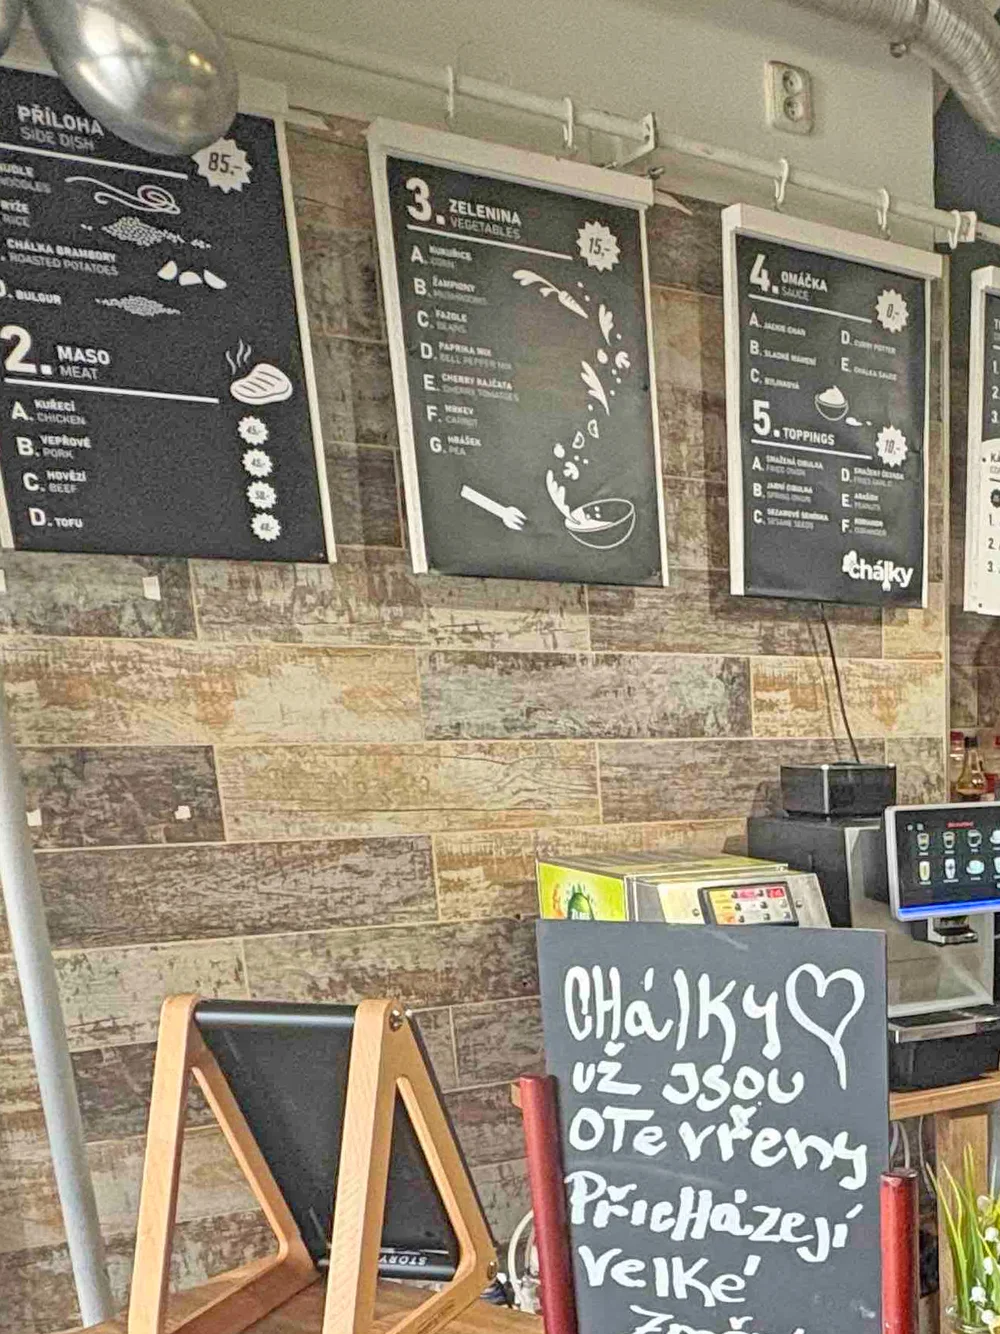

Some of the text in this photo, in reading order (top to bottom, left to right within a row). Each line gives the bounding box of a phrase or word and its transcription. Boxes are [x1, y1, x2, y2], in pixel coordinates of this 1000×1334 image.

[17, 102, 104, 137] PŘÍLOHA
[20, 126, 95, 151] SIDE DISH
[405, 177, 522, 228] 3. ZELENINA
[450, 213, 521, 241] VEGETABLES
[9, 252, 119, 277] ROASTED POTATOES
[781, 269, 828, 293] OMÁČKA
[56, 344, 111, 366] MASO
[59, 364, 99, 381] MEAT
[37, 412, 87, 426] CHICKEN
[782, 426, 835, 446] TOPPINGS
[42, 447, 74, 460] PORK
[48, 482, 78, 494] BEEF
[54, 517, 84, 529] TOFU
